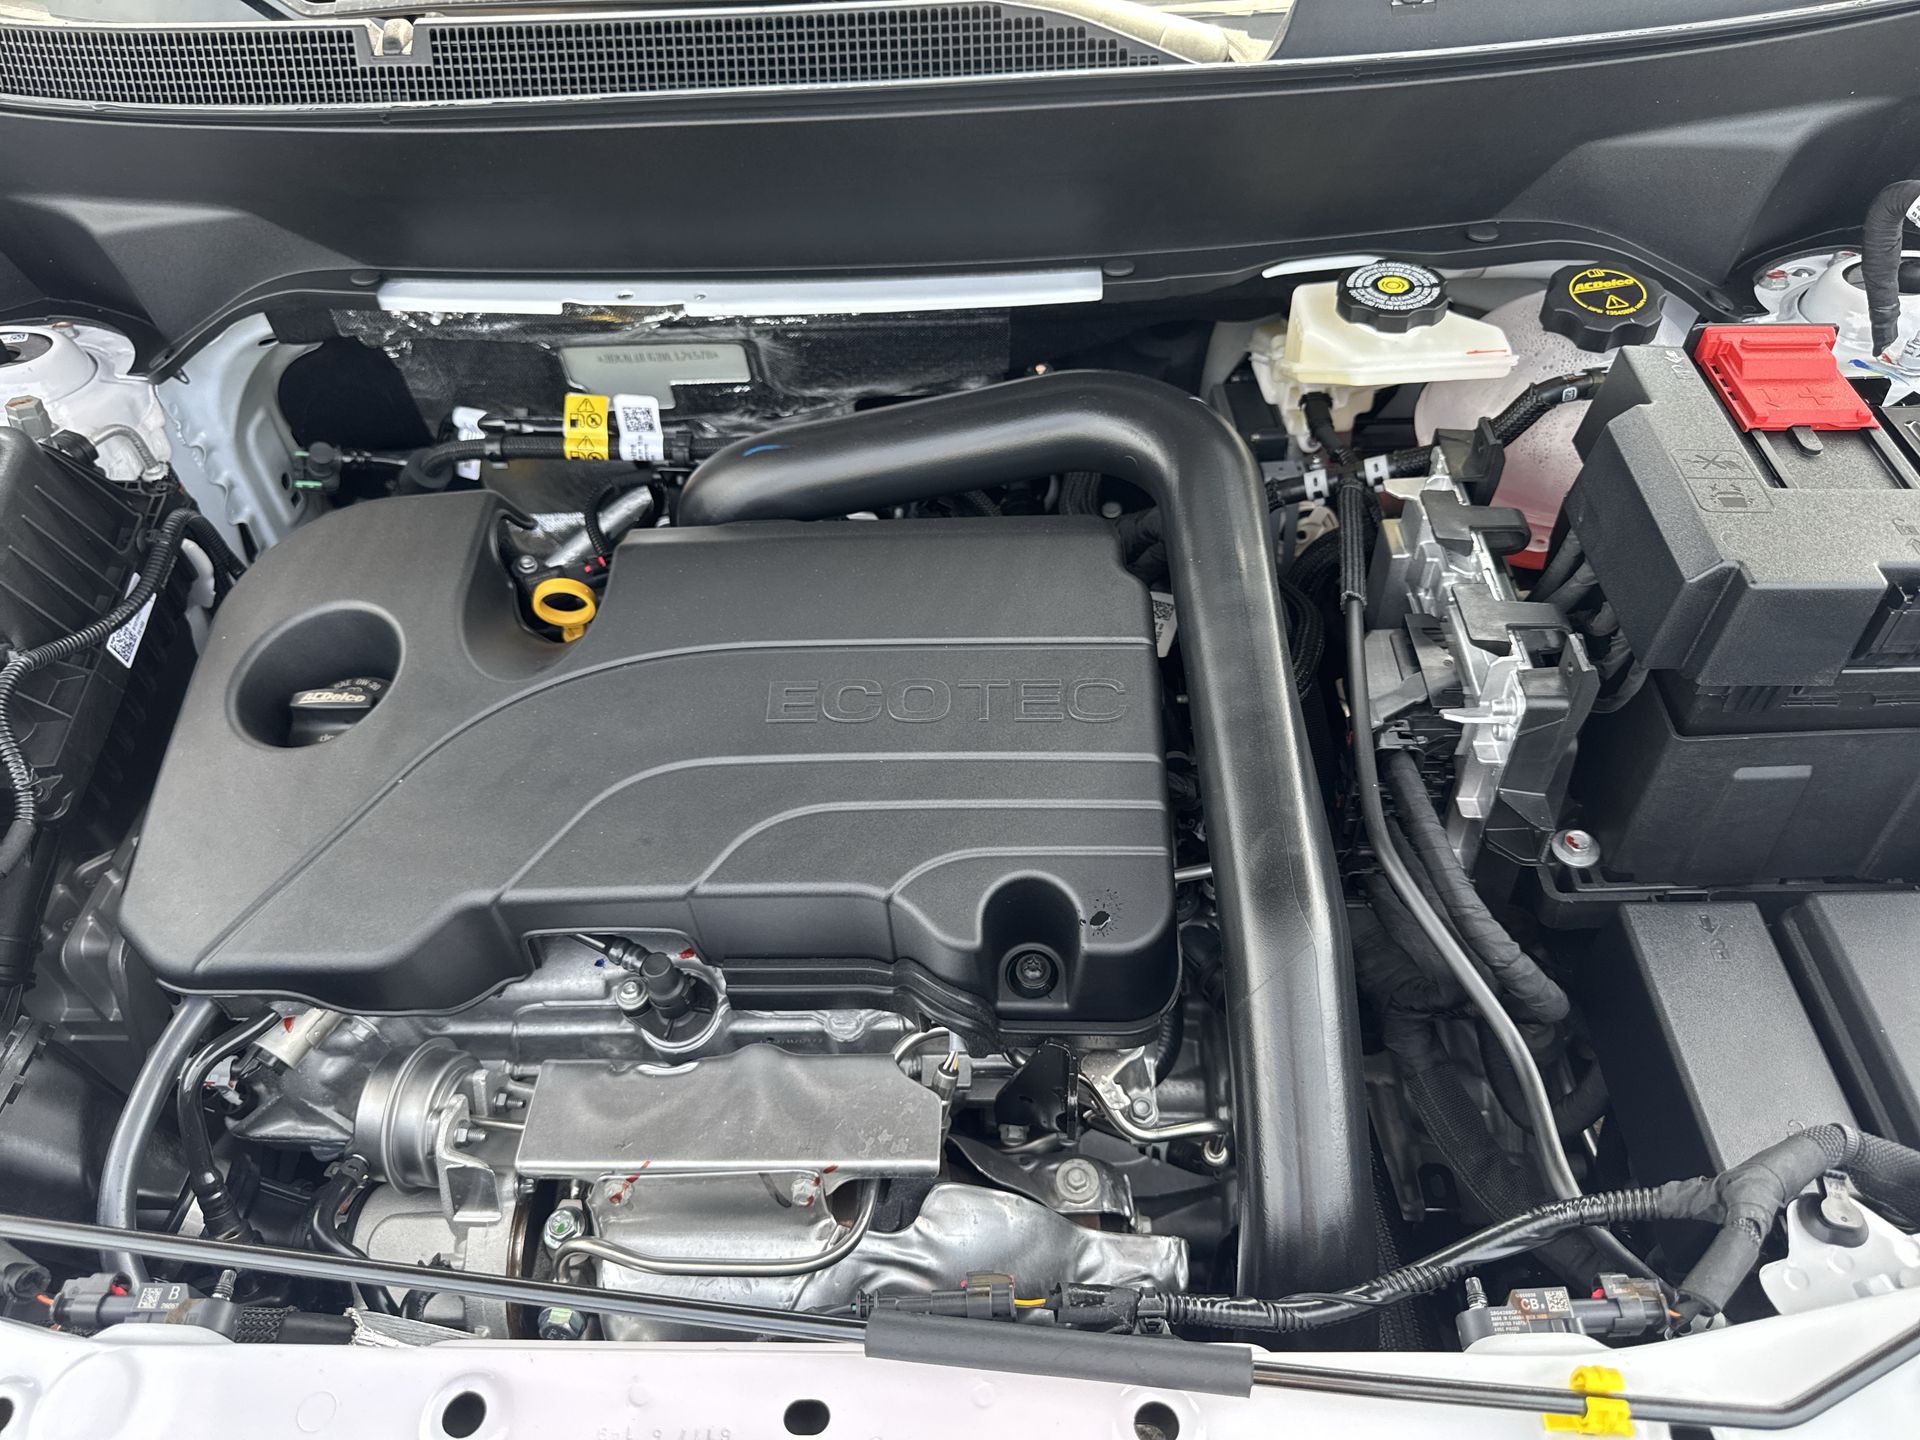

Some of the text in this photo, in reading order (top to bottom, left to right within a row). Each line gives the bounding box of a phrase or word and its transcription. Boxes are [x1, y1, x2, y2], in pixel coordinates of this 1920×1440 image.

[1573, 278, 1634, 293] ACDelco
[299, 692, 367, 704] ACDelco
[765, 678, 1127, 723] ECOTEC
[168, 1286, 181, 1300] B
